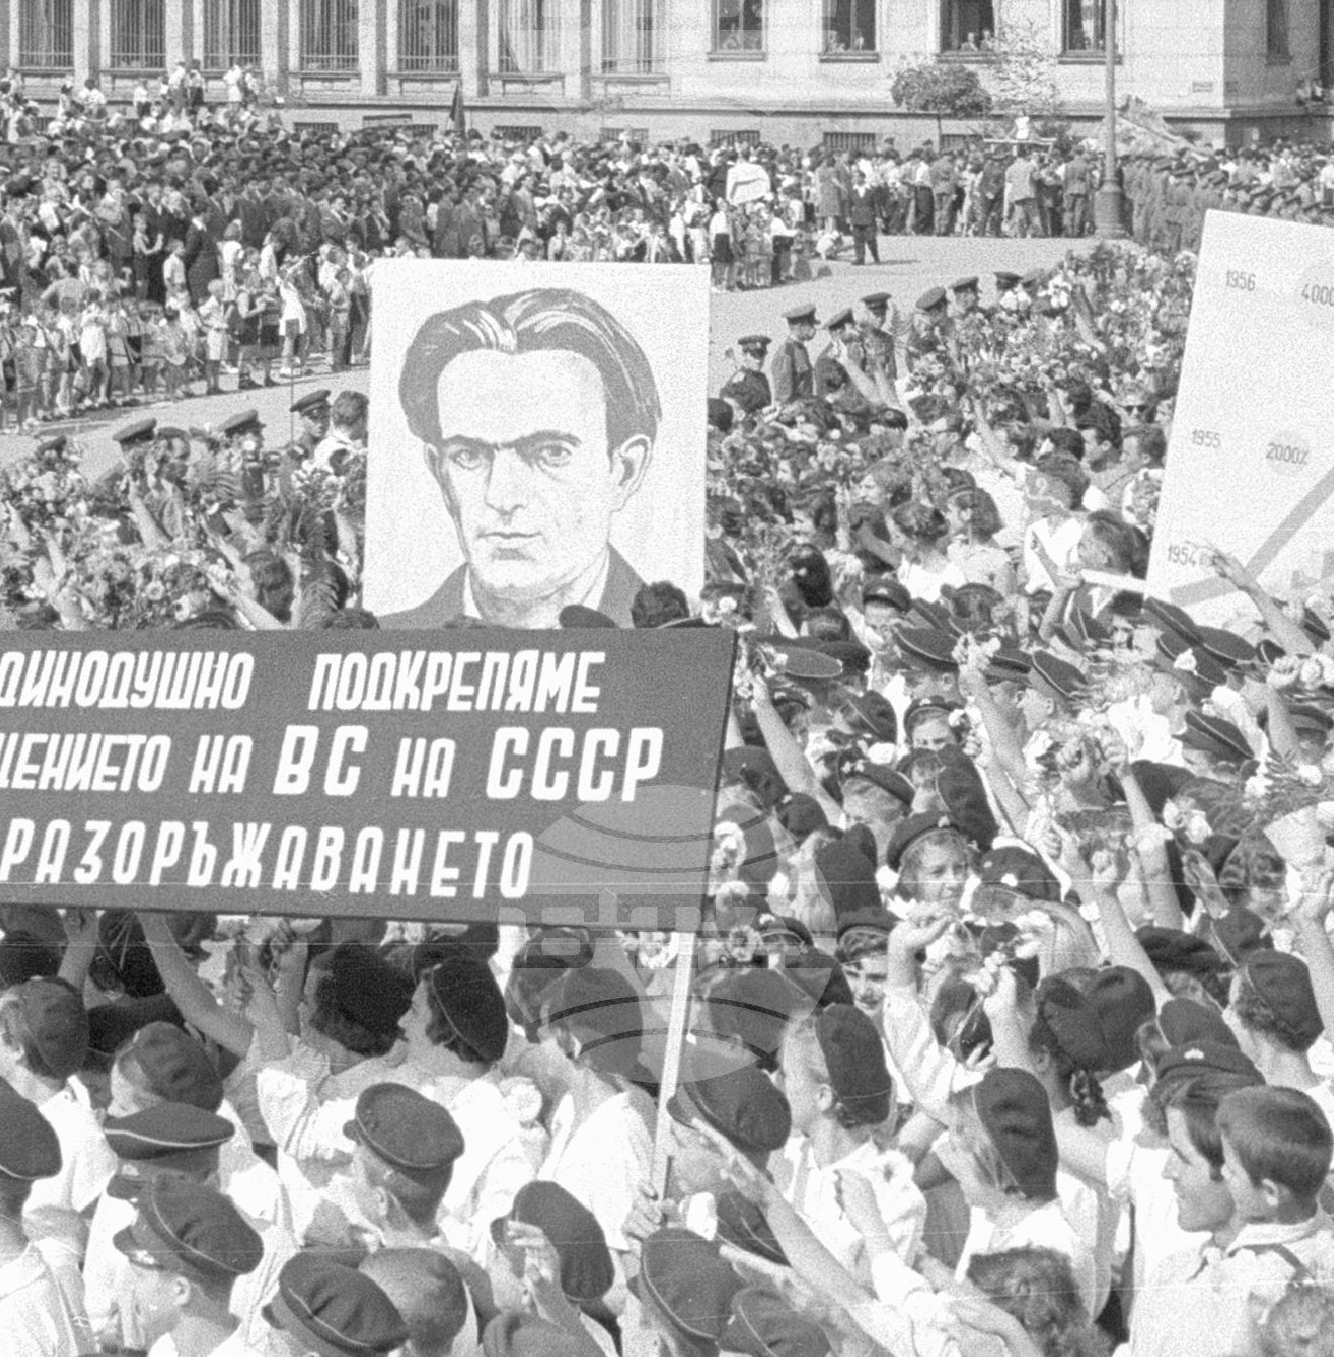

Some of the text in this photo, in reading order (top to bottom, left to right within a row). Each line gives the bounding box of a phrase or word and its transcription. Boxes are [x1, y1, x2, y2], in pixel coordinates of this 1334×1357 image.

[1225, 270, 1256, 291] 1956
[1192, 429, 1221, 448] 1955
[308, 649, 605, 713] ПОДКРЕПЯМЕ
[188, 735, 253, 793] НА
[273, 725, 368, 795] ВС
[391, 738, 455, 797] НА
[486, 727, 663, 802] СССР
